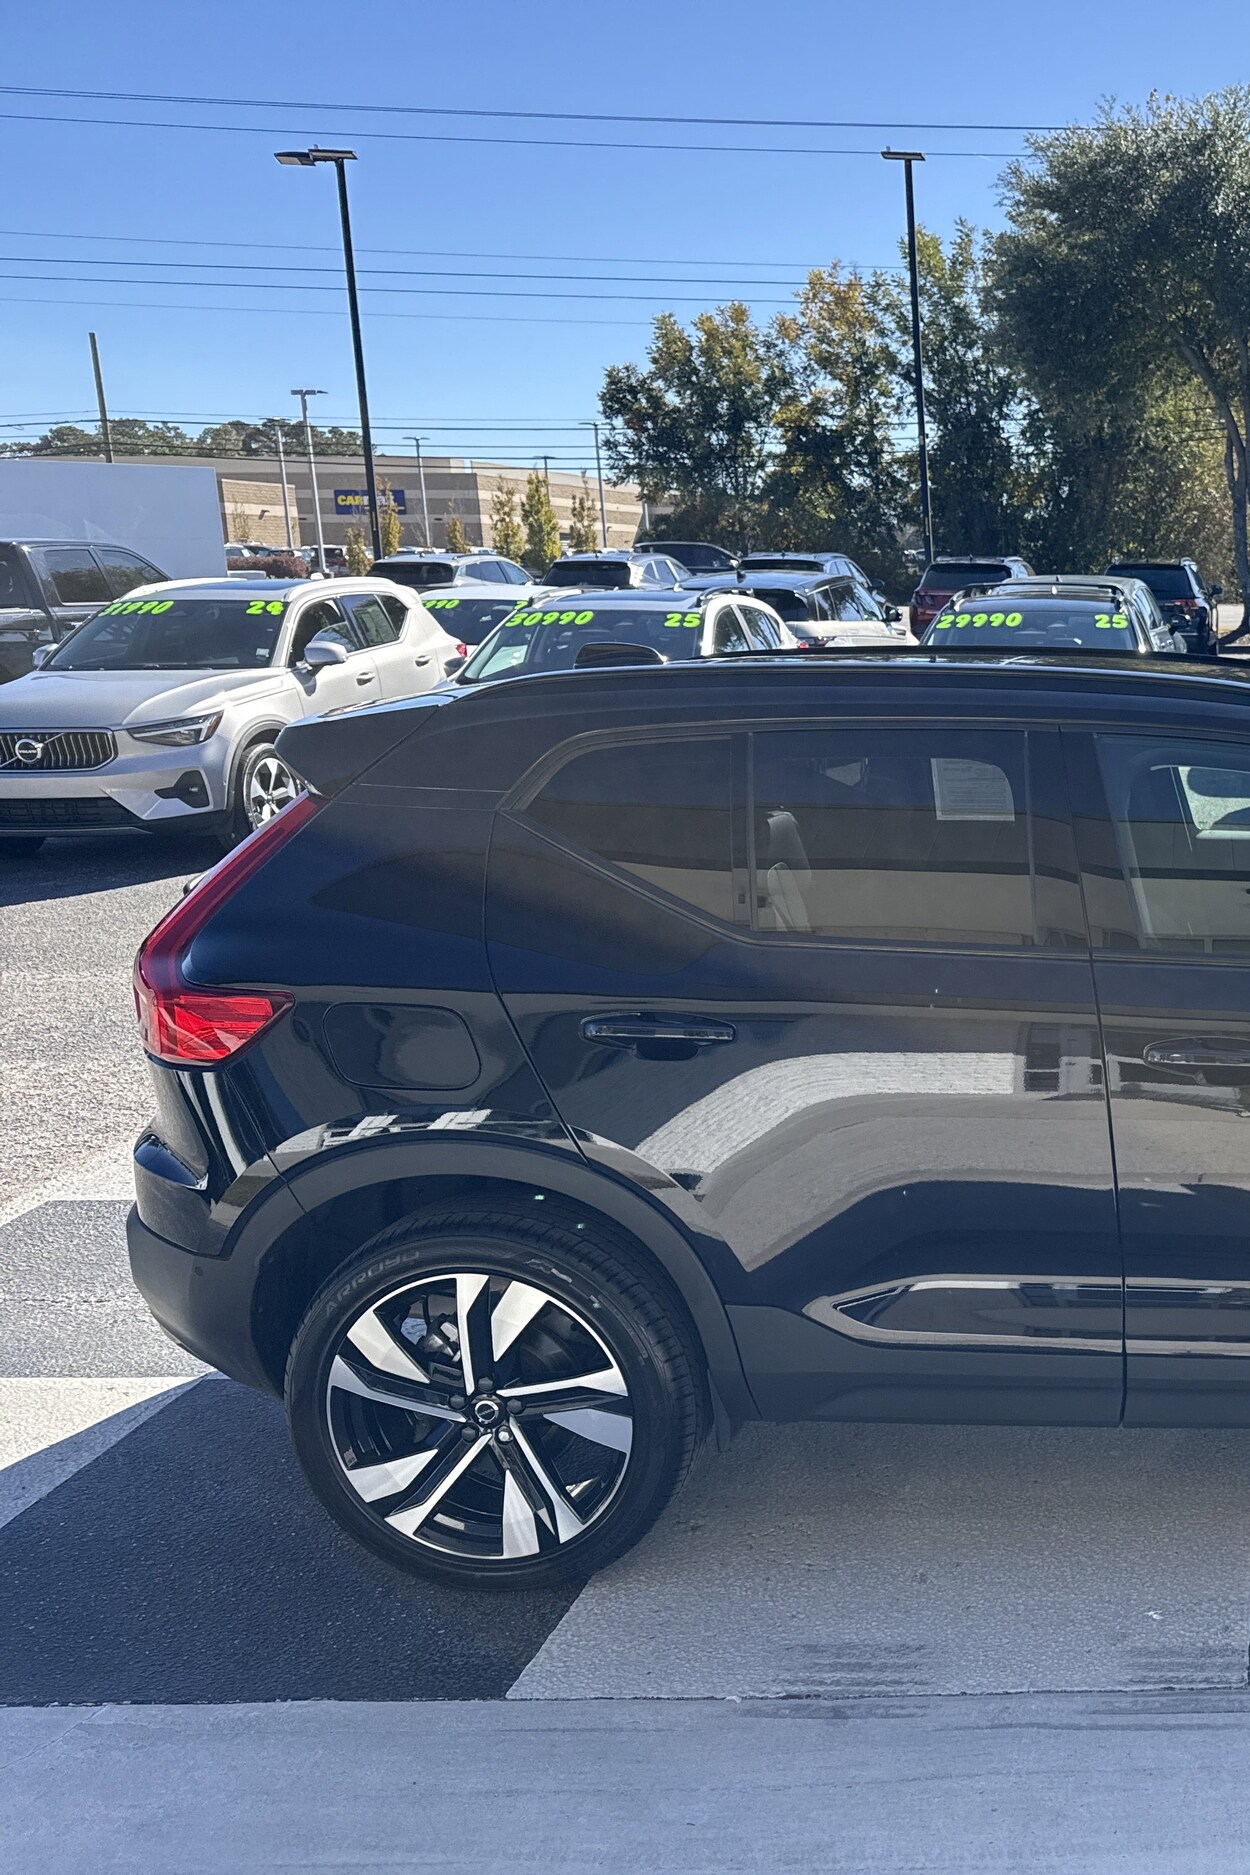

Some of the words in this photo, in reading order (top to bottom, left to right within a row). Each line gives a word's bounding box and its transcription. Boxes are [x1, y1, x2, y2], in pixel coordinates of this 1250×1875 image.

[98, 600, 175, 617] 31990
[246, 601, 285, 616] 24
[421, 599, 460, 609] 990
[504, 610, 594, 628] 30990
[664, 613, 701, 628] 25
[935, 612, 1023, 629] 29990
[1094, 614, 1129, 629] 25
